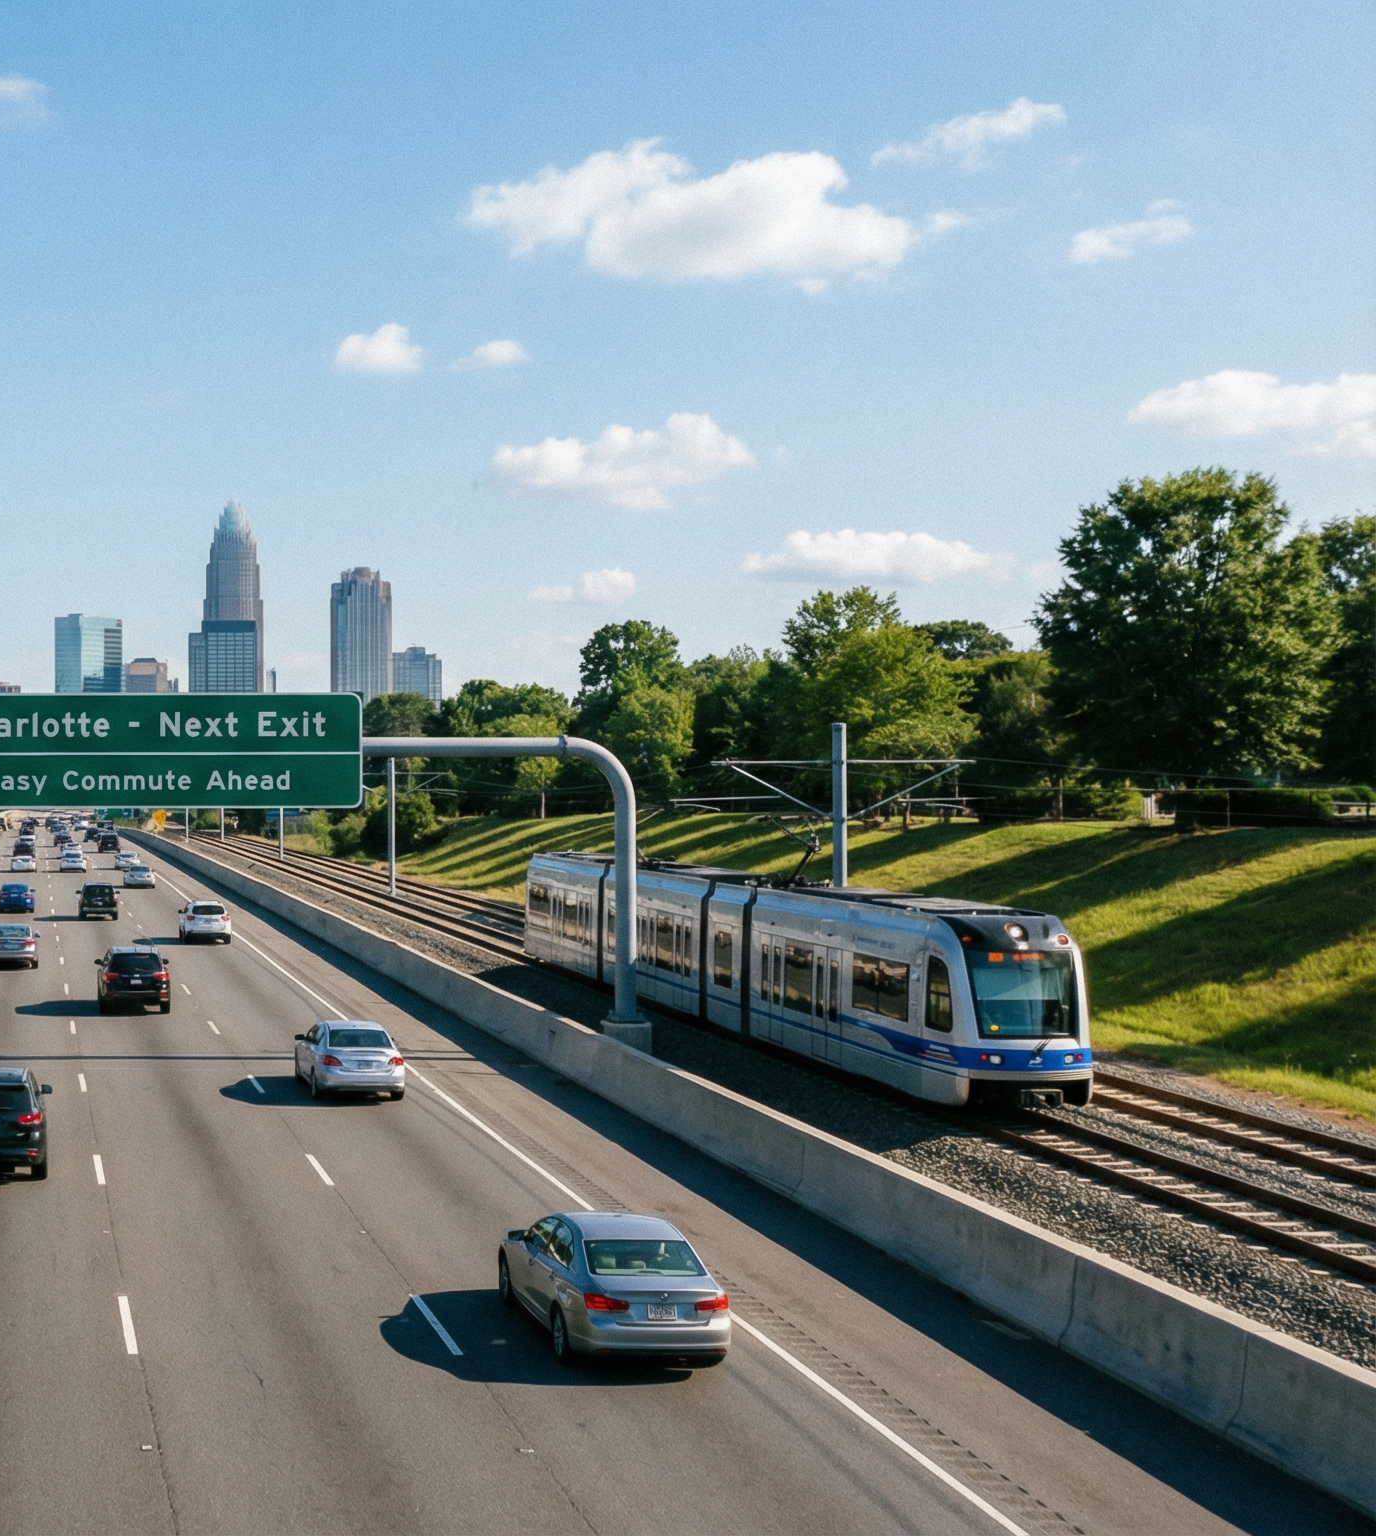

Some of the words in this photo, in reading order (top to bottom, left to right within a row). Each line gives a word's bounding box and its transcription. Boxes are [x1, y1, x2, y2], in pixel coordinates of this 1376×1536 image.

[159, 711, 239, 738] Next
[257, 711, 326, 737] Exit
[62, 770, 192, 791] Commute
[206, 770, 290, 791] Ahead
